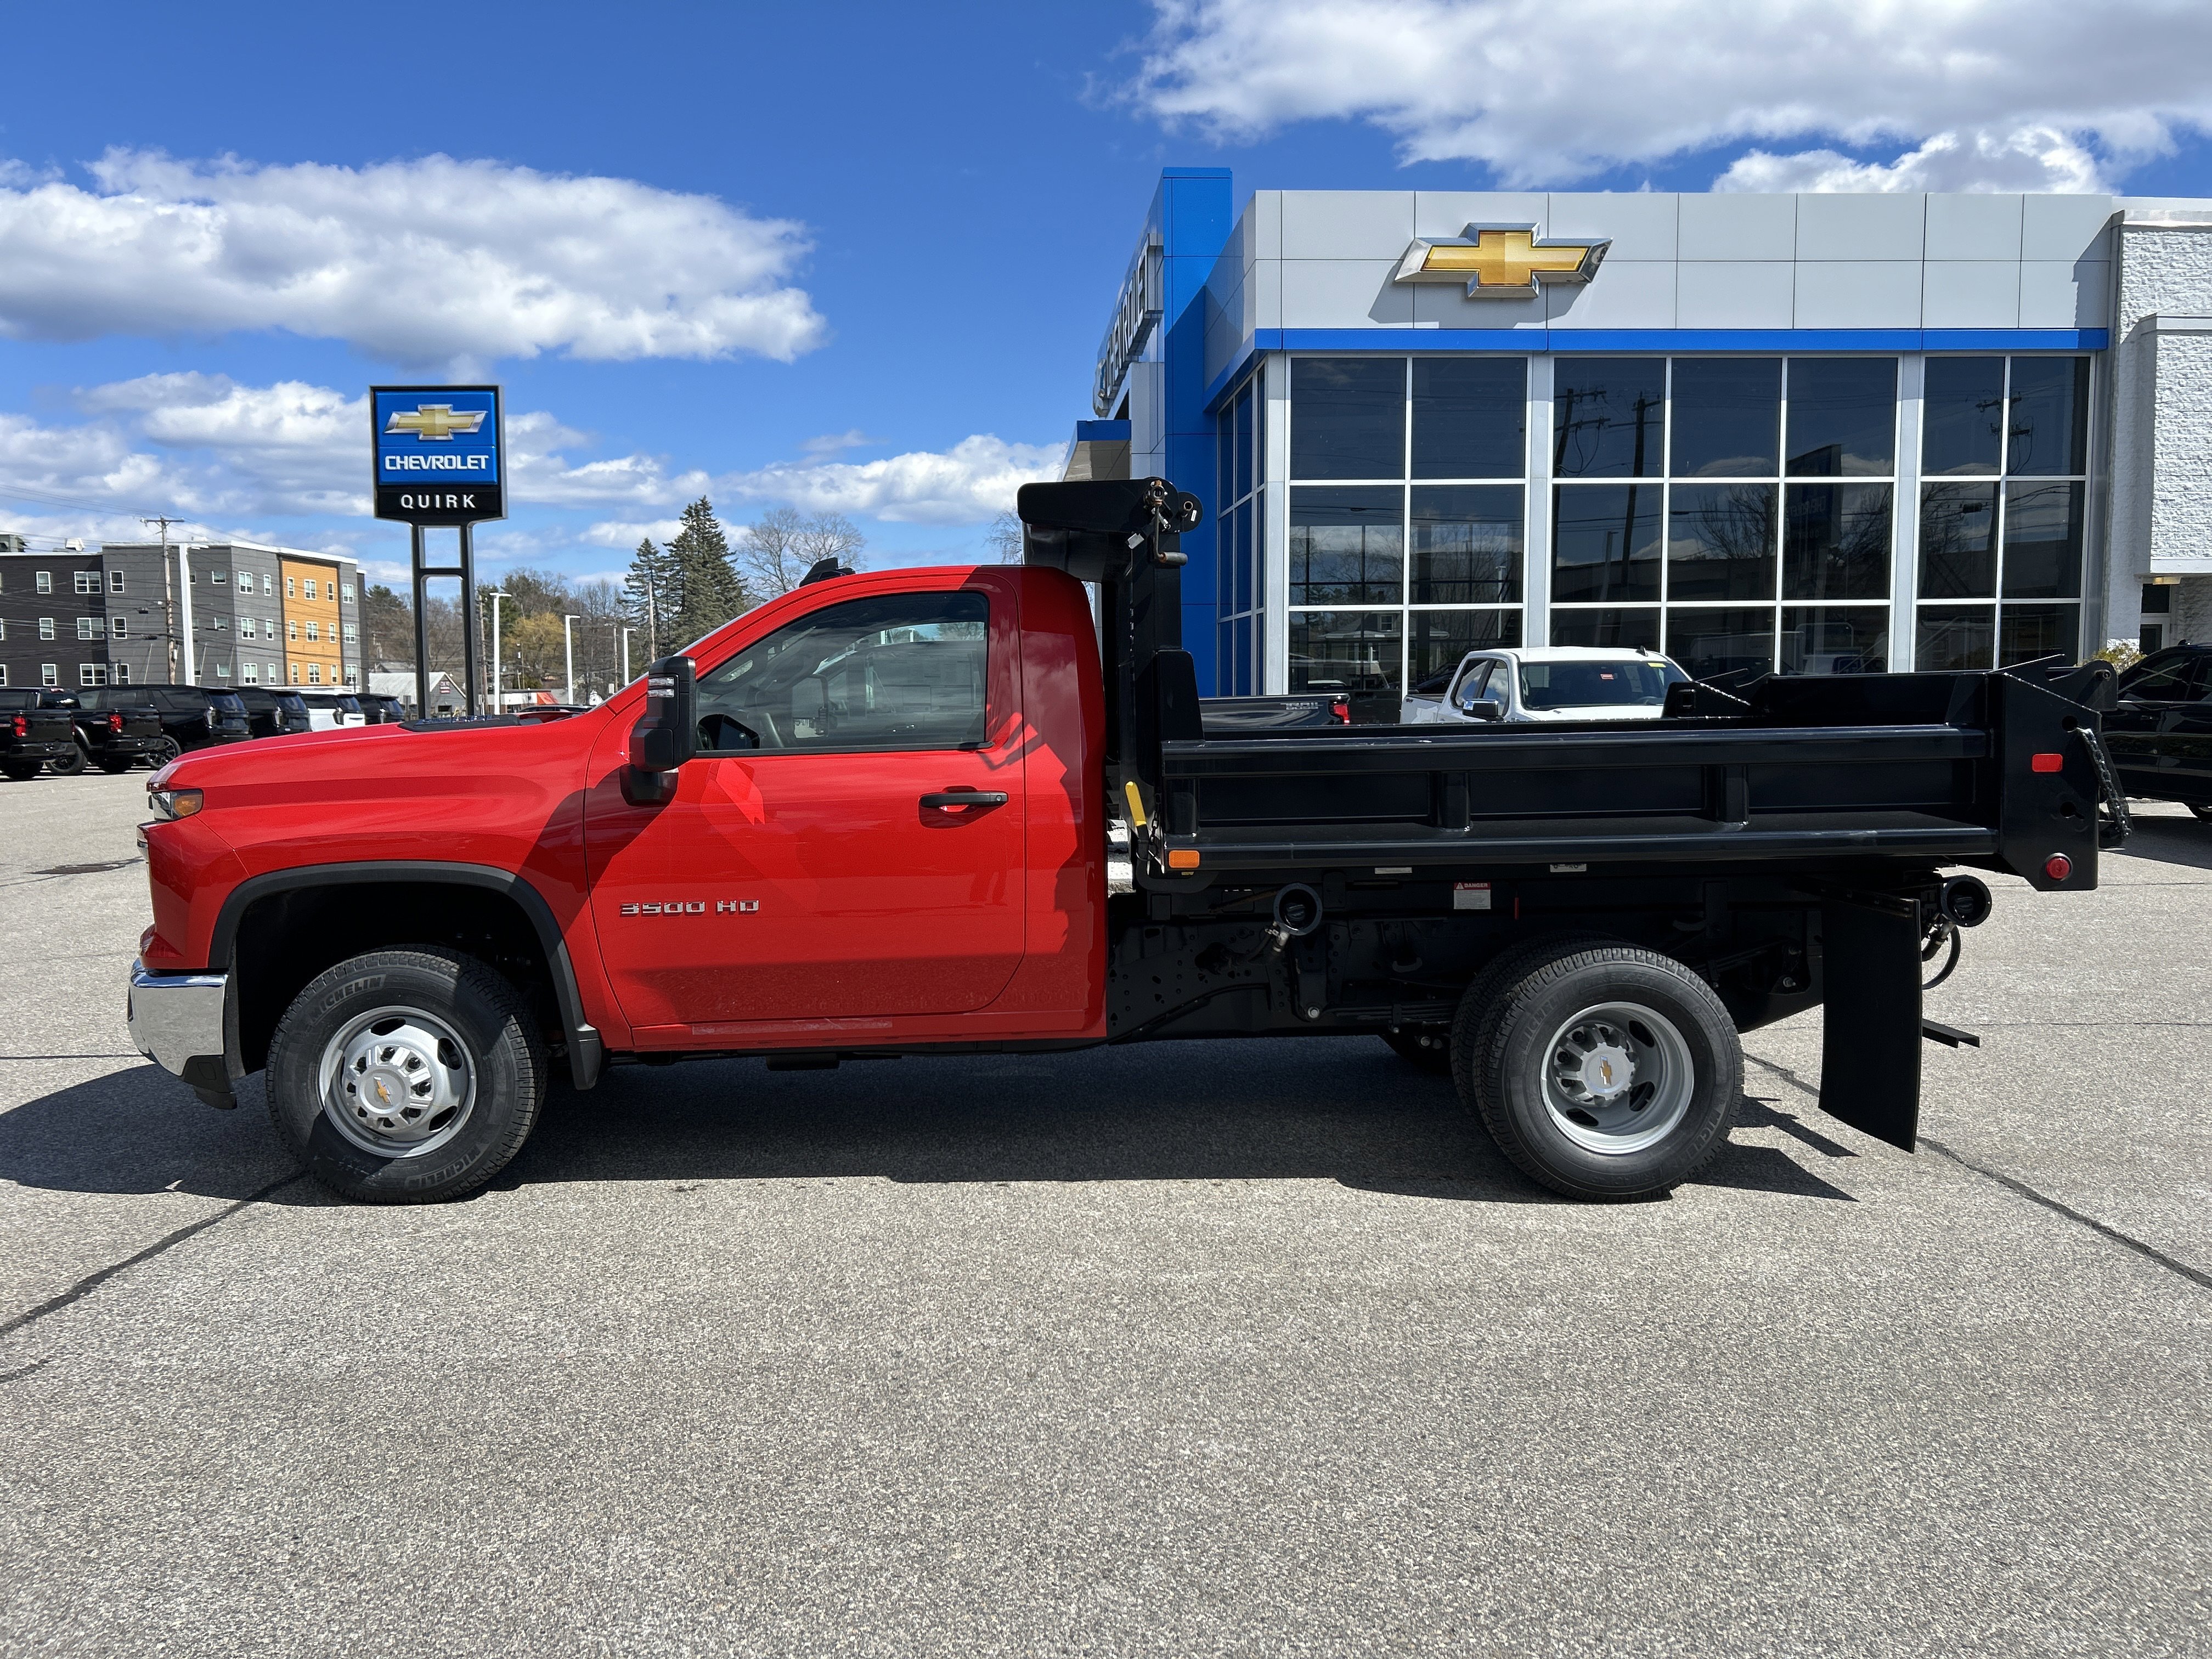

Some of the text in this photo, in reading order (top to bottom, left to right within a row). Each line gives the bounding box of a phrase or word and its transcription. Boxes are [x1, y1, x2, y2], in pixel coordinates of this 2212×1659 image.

[385, 455, 489, 470] CHEVROLET
[400, 494, 476, 509] QUIRK
[620, 900, 759, 915] 3500 HD
[311, 977, 382, 1024] MICHELIN
[410, 1144, 481, 1189] MICHELIN
